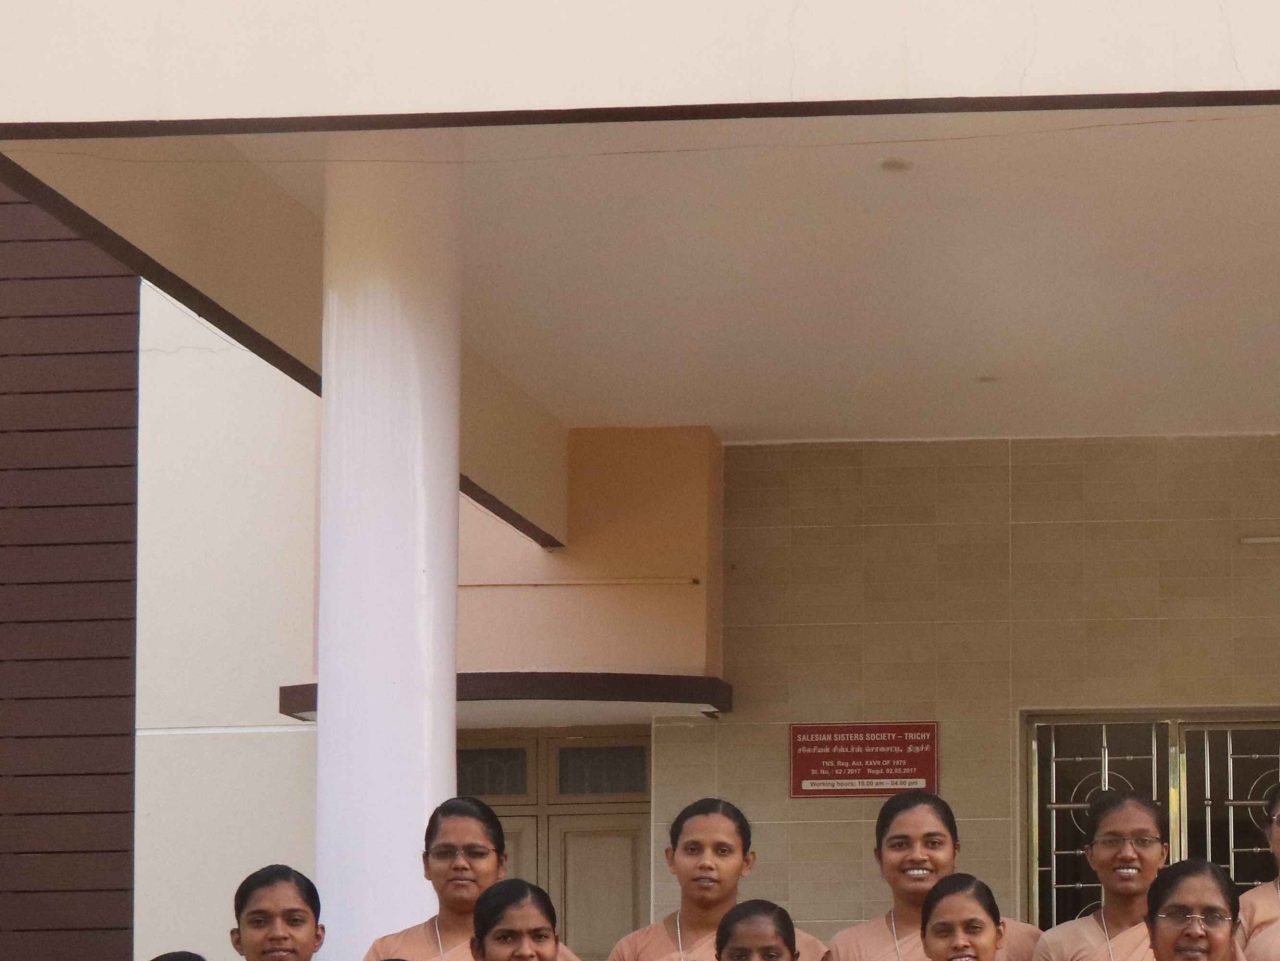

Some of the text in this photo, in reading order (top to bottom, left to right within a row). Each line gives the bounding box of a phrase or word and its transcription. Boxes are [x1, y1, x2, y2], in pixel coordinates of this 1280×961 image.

[797, 733, 832, 742] SALESIAN
[833, 733, 864, 741] SISTERS
[865, 732, 896, 741] SOCIETY
[904, 732, 931, 740] TRICHY
